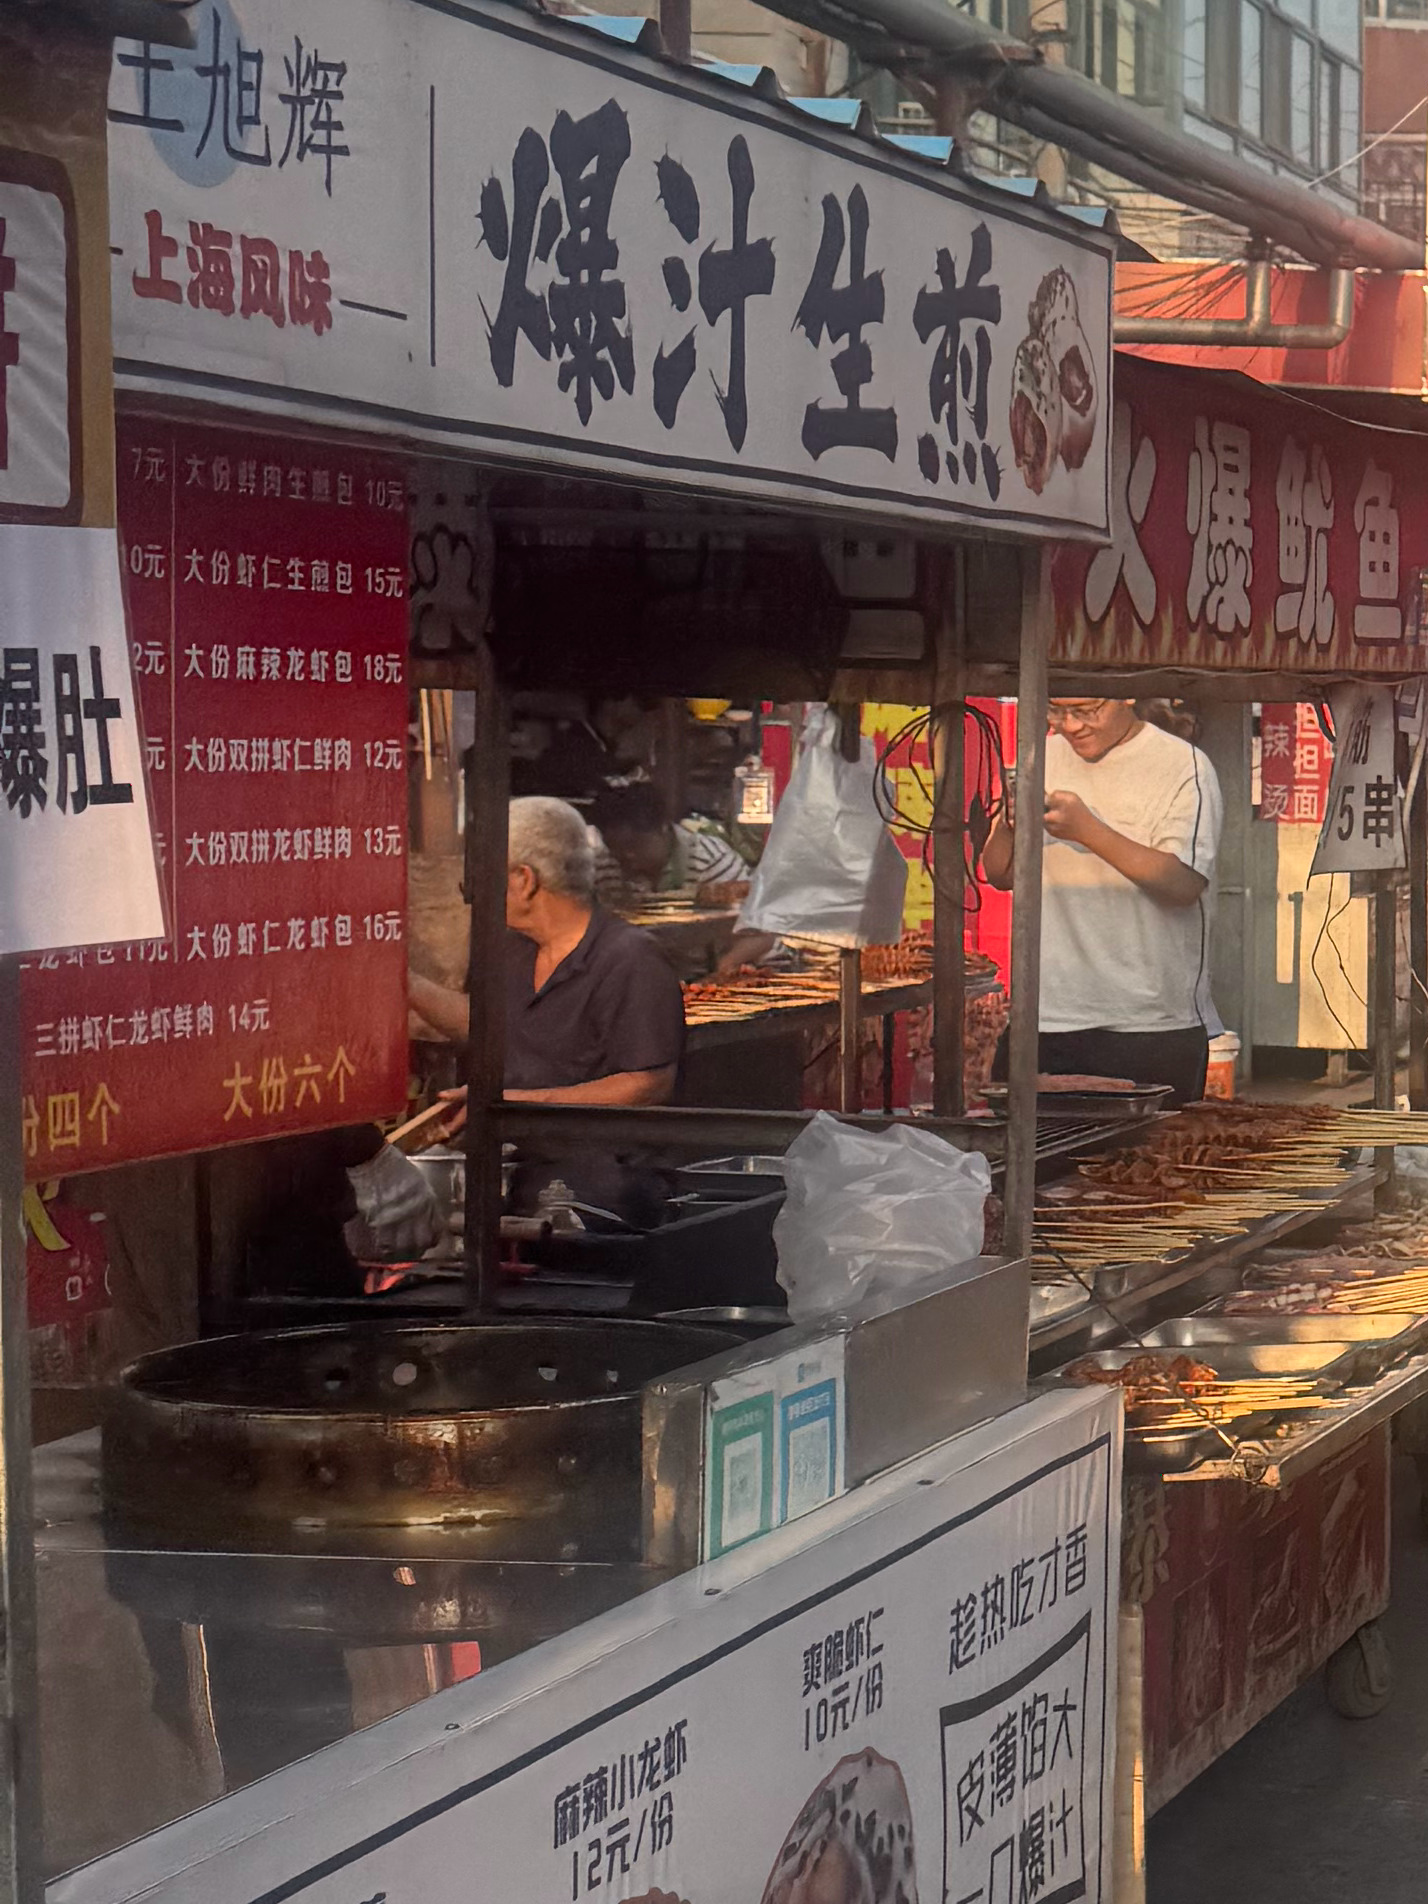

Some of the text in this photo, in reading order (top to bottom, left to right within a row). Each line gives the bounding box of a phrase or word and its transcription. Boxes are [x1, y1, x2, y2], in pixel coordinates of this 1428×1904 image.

[132, 209, 334, 336] 上海风味
[475, 97, 1003, 502] 爆汁生煎
[1085, 401, 1402, 646] 火爆鱿鱼
[184, 547, 404, 598] 大份虾仁生煎包 15元
[184, 643, 404, 684] 大份麻辣龙虾包 18元
[184, 737, 404, 774] 大份双拼虾仁鲜肉 12元
[185, 825, 404, 868] 大份双拼龙虾鲜肉 13元
[186, 910, 403, 963] 大份虾仁龙虾包 16元
[34, 998, 271, 1058] 三拼虾仁龙虾鲜肉 14元
[223, 1045, 357, 1123] 大份六个
[948, 1522, 1088, 1675] 趁热吃才香
[802, 1606, 885, 1698] 爽脆虾仁
[803, 1660, 885, 1752] 10元/份
[553, 1718, 688, 1849] 麻辣小龙虾
[957, 1687, 1078, 1848] 皮薄馅大
[572, 1791, 674, 1902] 12元/份
